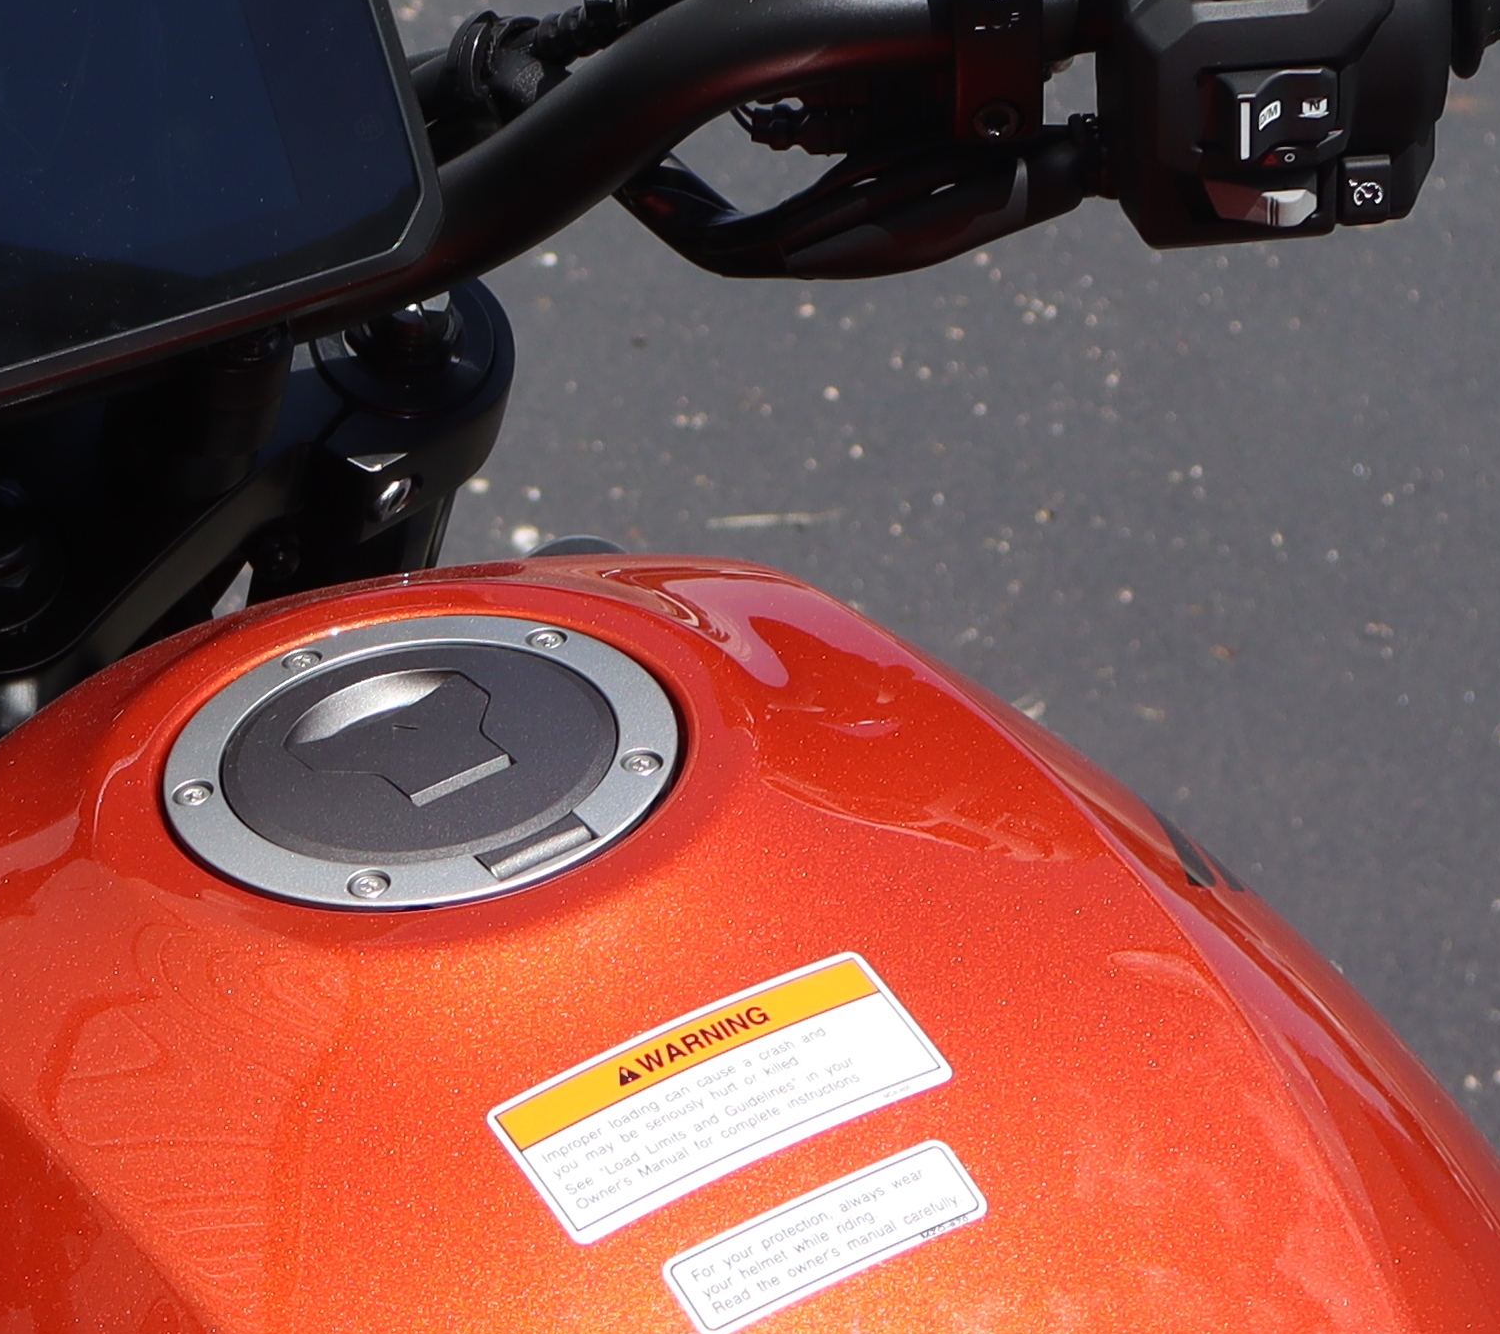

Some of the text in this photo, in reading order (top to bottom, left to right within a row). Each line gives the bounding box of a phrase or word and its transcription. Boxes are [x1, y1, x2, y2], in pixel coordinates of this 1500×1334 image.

[540, 1026, 827, 1164] Improper loading can cause a crash and
[634, 1005, 772, 1074] WARNING
[552, 1054, 800, 1181] you may be seriously hurt or killed
[575, 1071, 862, 1210] Owner's Manual for complete instructions
[689, 1167, 925, 1284] For your protection, always wear
[701, 1276, 734, 1302] your
[738, 1249, 789, 1281] helmet
[792, 1229, 831, 1255] while
[711, 1287, 752, 1316] Read
[756, 1274, 782, 1294] the
[786, 1246, 842, 1279] owner's
[846, 1219, 898, 1252] manual
